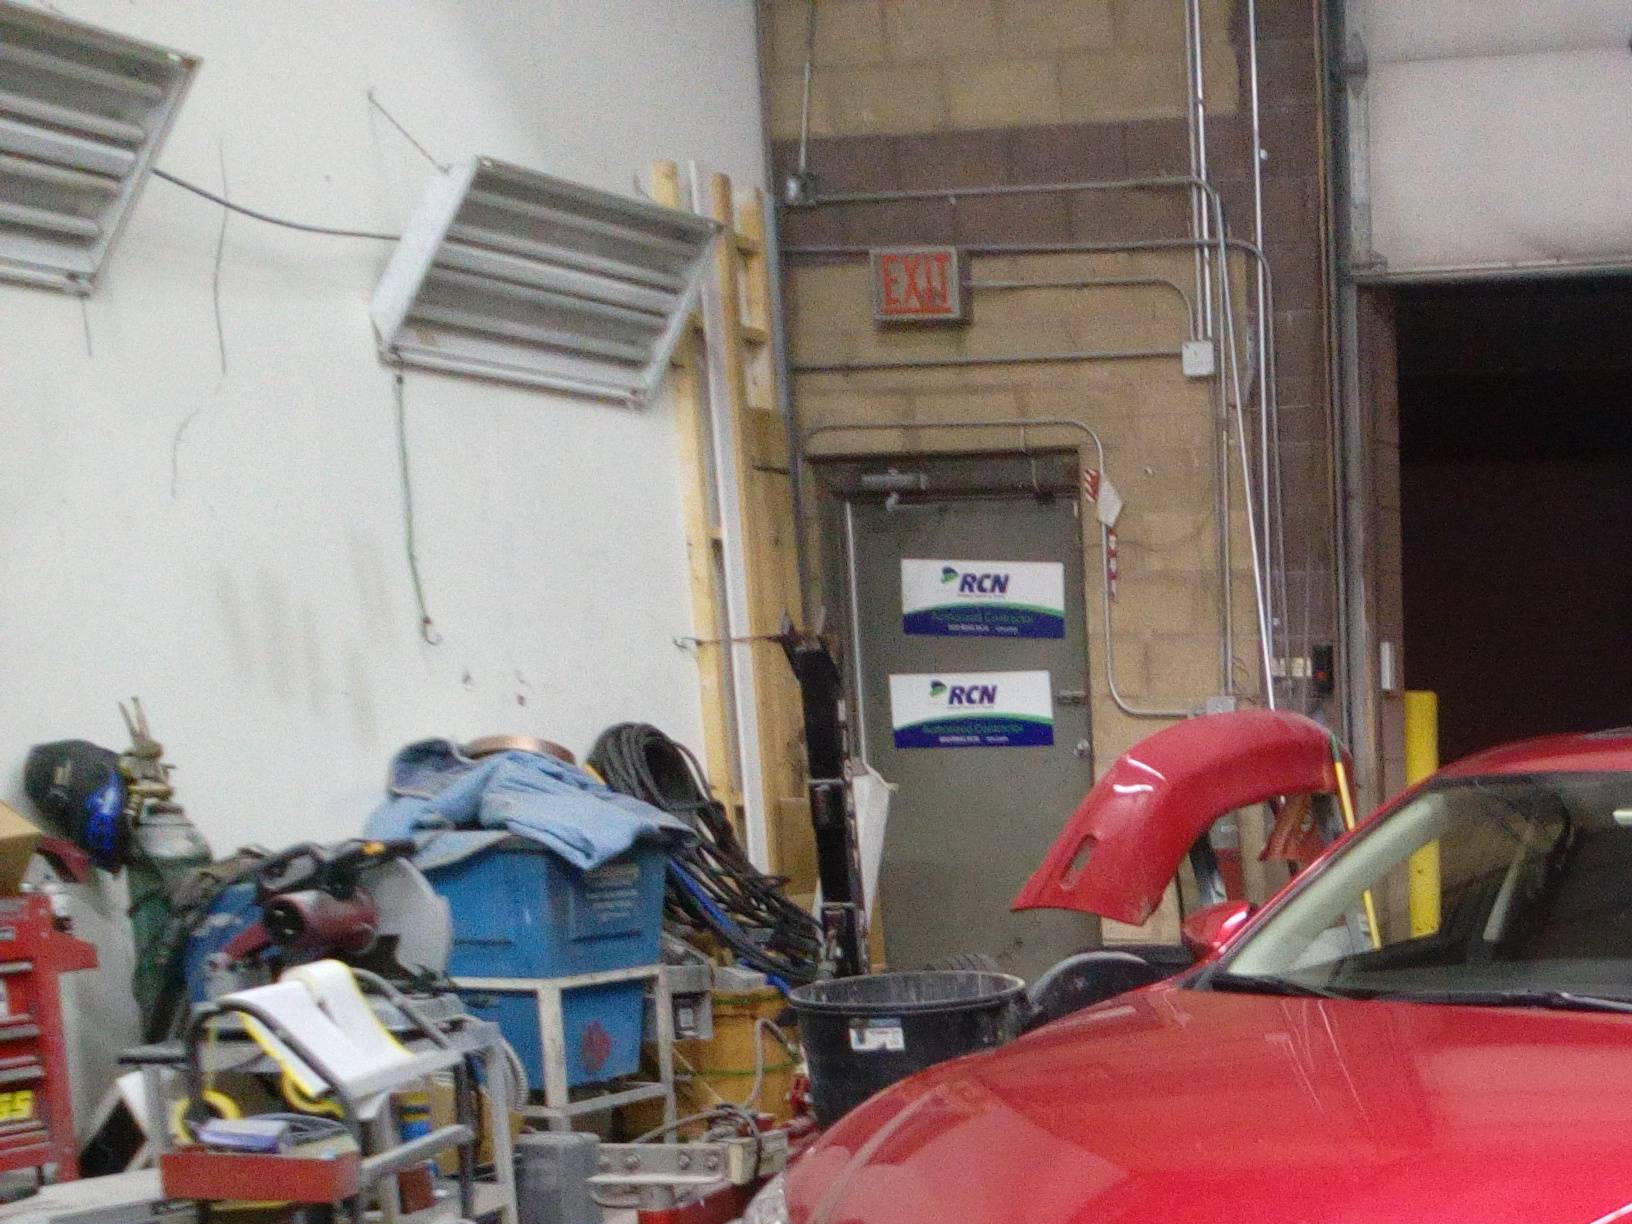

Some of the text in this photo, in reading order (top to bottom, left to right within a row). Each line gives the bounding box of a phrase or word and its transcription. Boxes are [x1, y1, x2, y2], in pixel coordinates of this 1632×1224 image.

[882, 252, 951, 305] EXIT
[959, 572, 1010, 593] RCN
[948, 684, 998, 705] RCN
